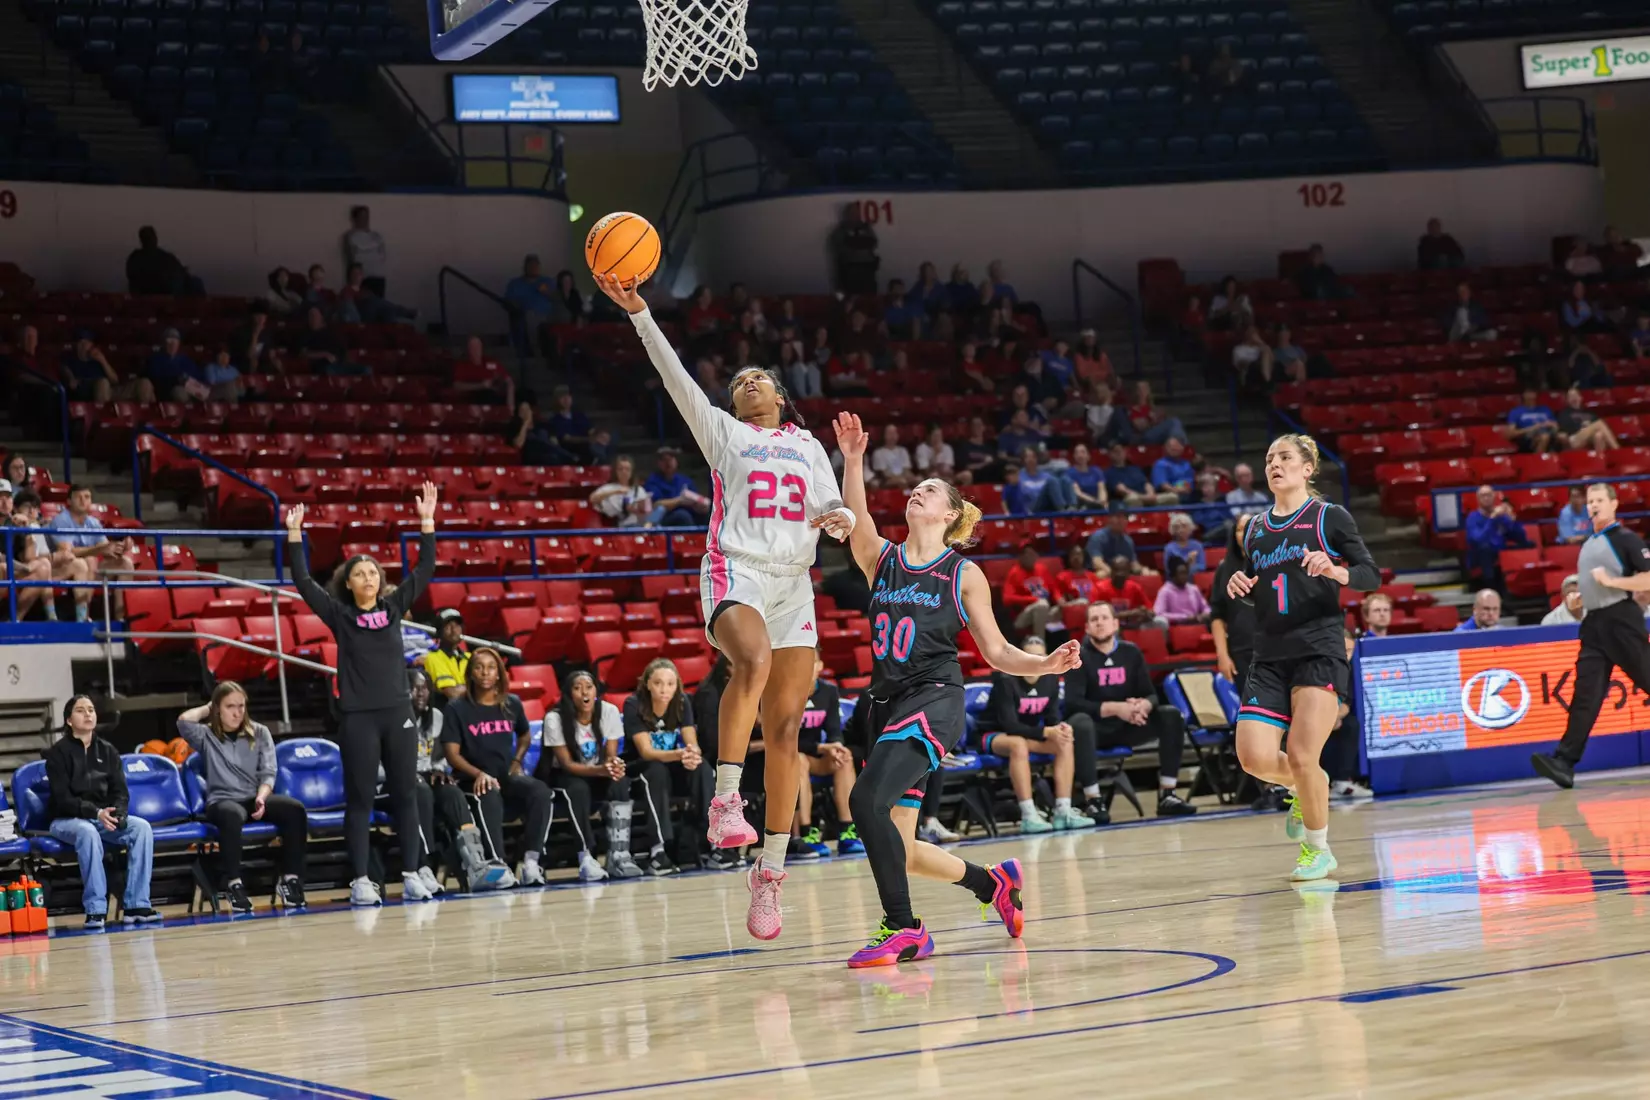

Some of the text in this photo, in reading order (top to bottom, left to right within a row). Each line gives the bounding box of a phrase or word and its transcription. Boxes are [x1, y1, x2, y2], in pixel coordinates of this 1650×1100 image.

[1531, 54, 1590, 76] Super
[1591, 45, 1612, 77] 1
[1297, 182, 1346, 208] 102
[854, 199, 893, 226] 01
[740, 443, 770, 463] Lady
[747, 470, 807, 522] 23
[870, 578, 941, 609] Panthers
[1272, 573, 1288, 614] 1
[873, 612, 915, 662] 30
[1379, 712, 1460, 737] Kubota
